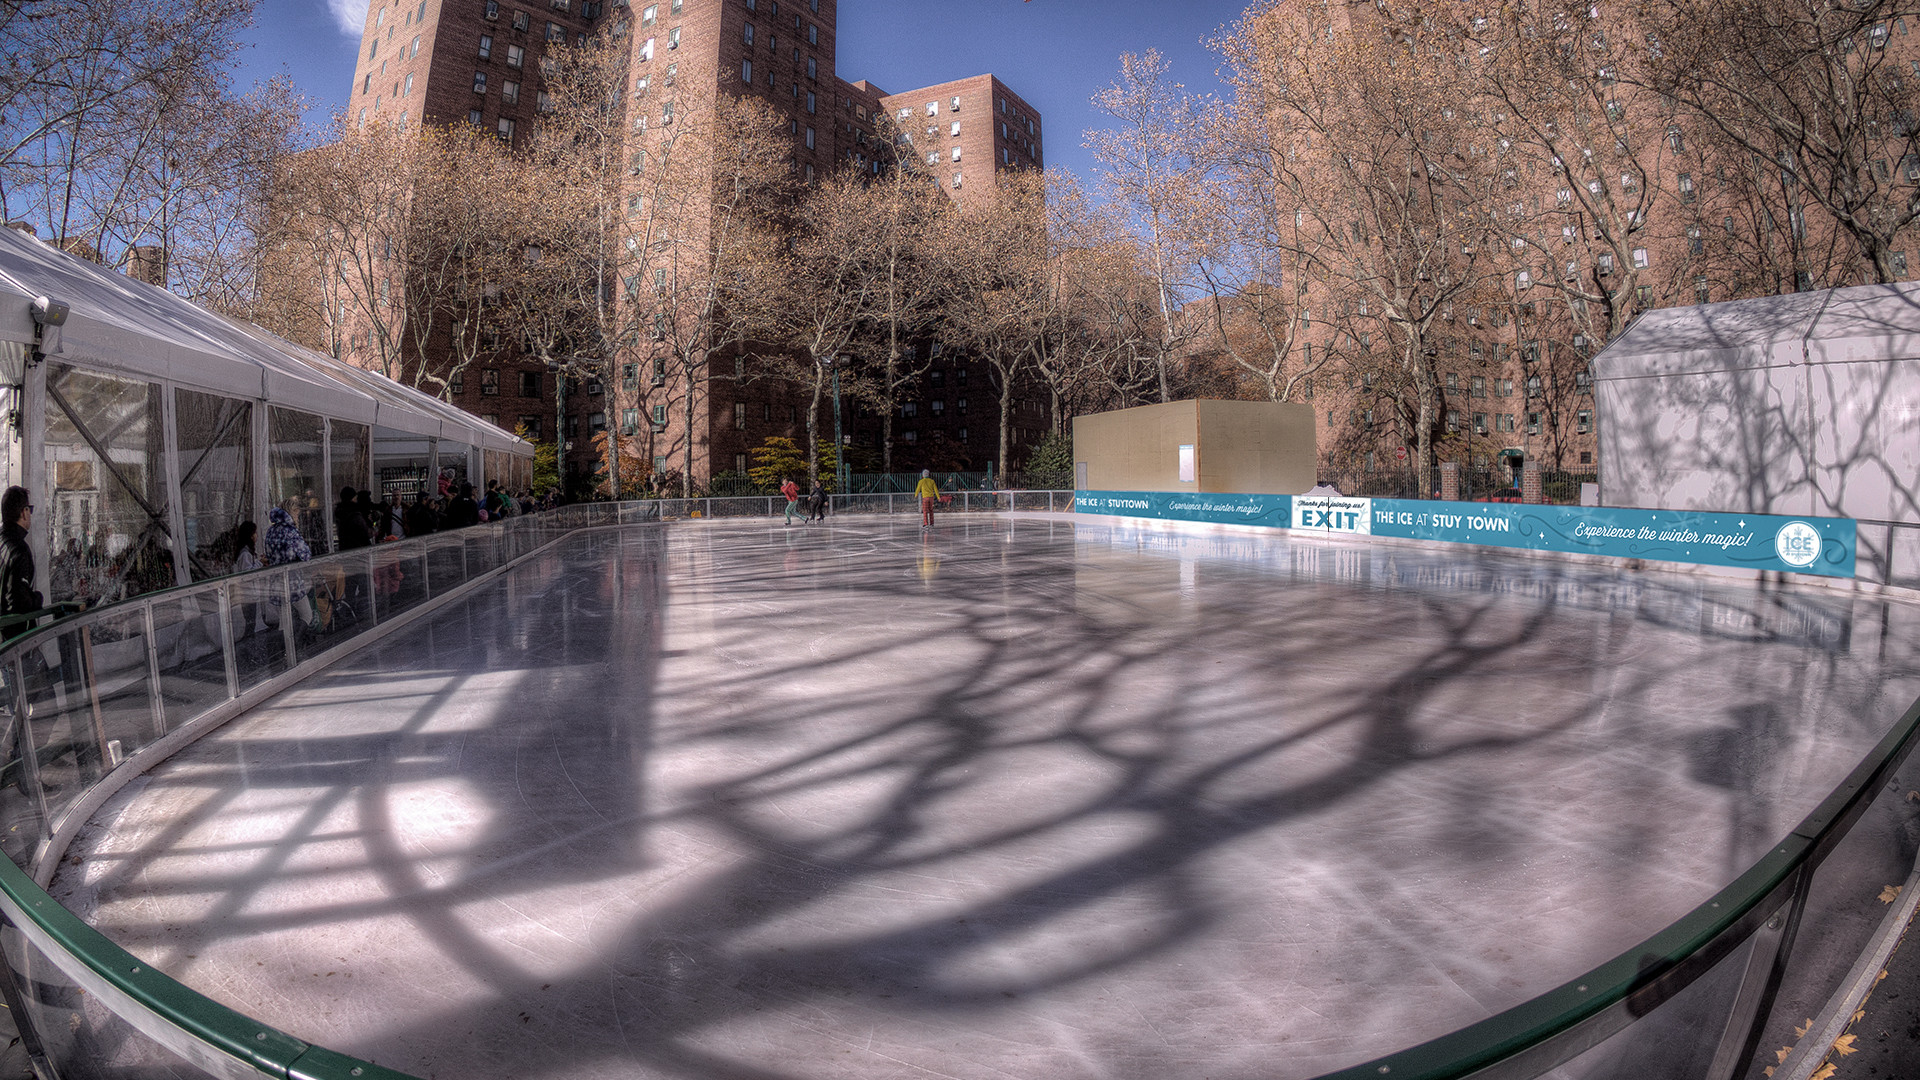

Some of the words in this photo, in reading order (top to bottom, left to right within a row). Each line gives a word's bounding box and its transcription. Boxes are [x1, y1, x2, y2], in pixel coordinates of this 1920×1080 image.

[1076, 497, 1087, 506] THE
[1088, 498, 1098, 507] ICE
[1099, 498, 1107, 507] AT
[1108, 499, 1149, 509] STUYTOWN
[1169, 501, 1202, 511] Experience
[1202, 502, 1212, 511] the
[1213, 503, 1235, 512] winter
[1236, 504, 1263, 515] magic!
[1302, 510, 1359, 530] EXIT
[1375, 510, 1394, 524] THE
[1397, 511, 1413, 525] ICE
[1416, 513, 1428, 526] AT
[1432, 514, 1461, 529] STUY
[1466, 515, 1509, 532] TOWN
[1574, 521, 1636, 540] Experience
[1637, 527, 1656, 541] the
[1658, 528, 1700, 544] winter
[1701, 532, 1754, 550] magic!
[1786, 536, 1811, 550] ICE
